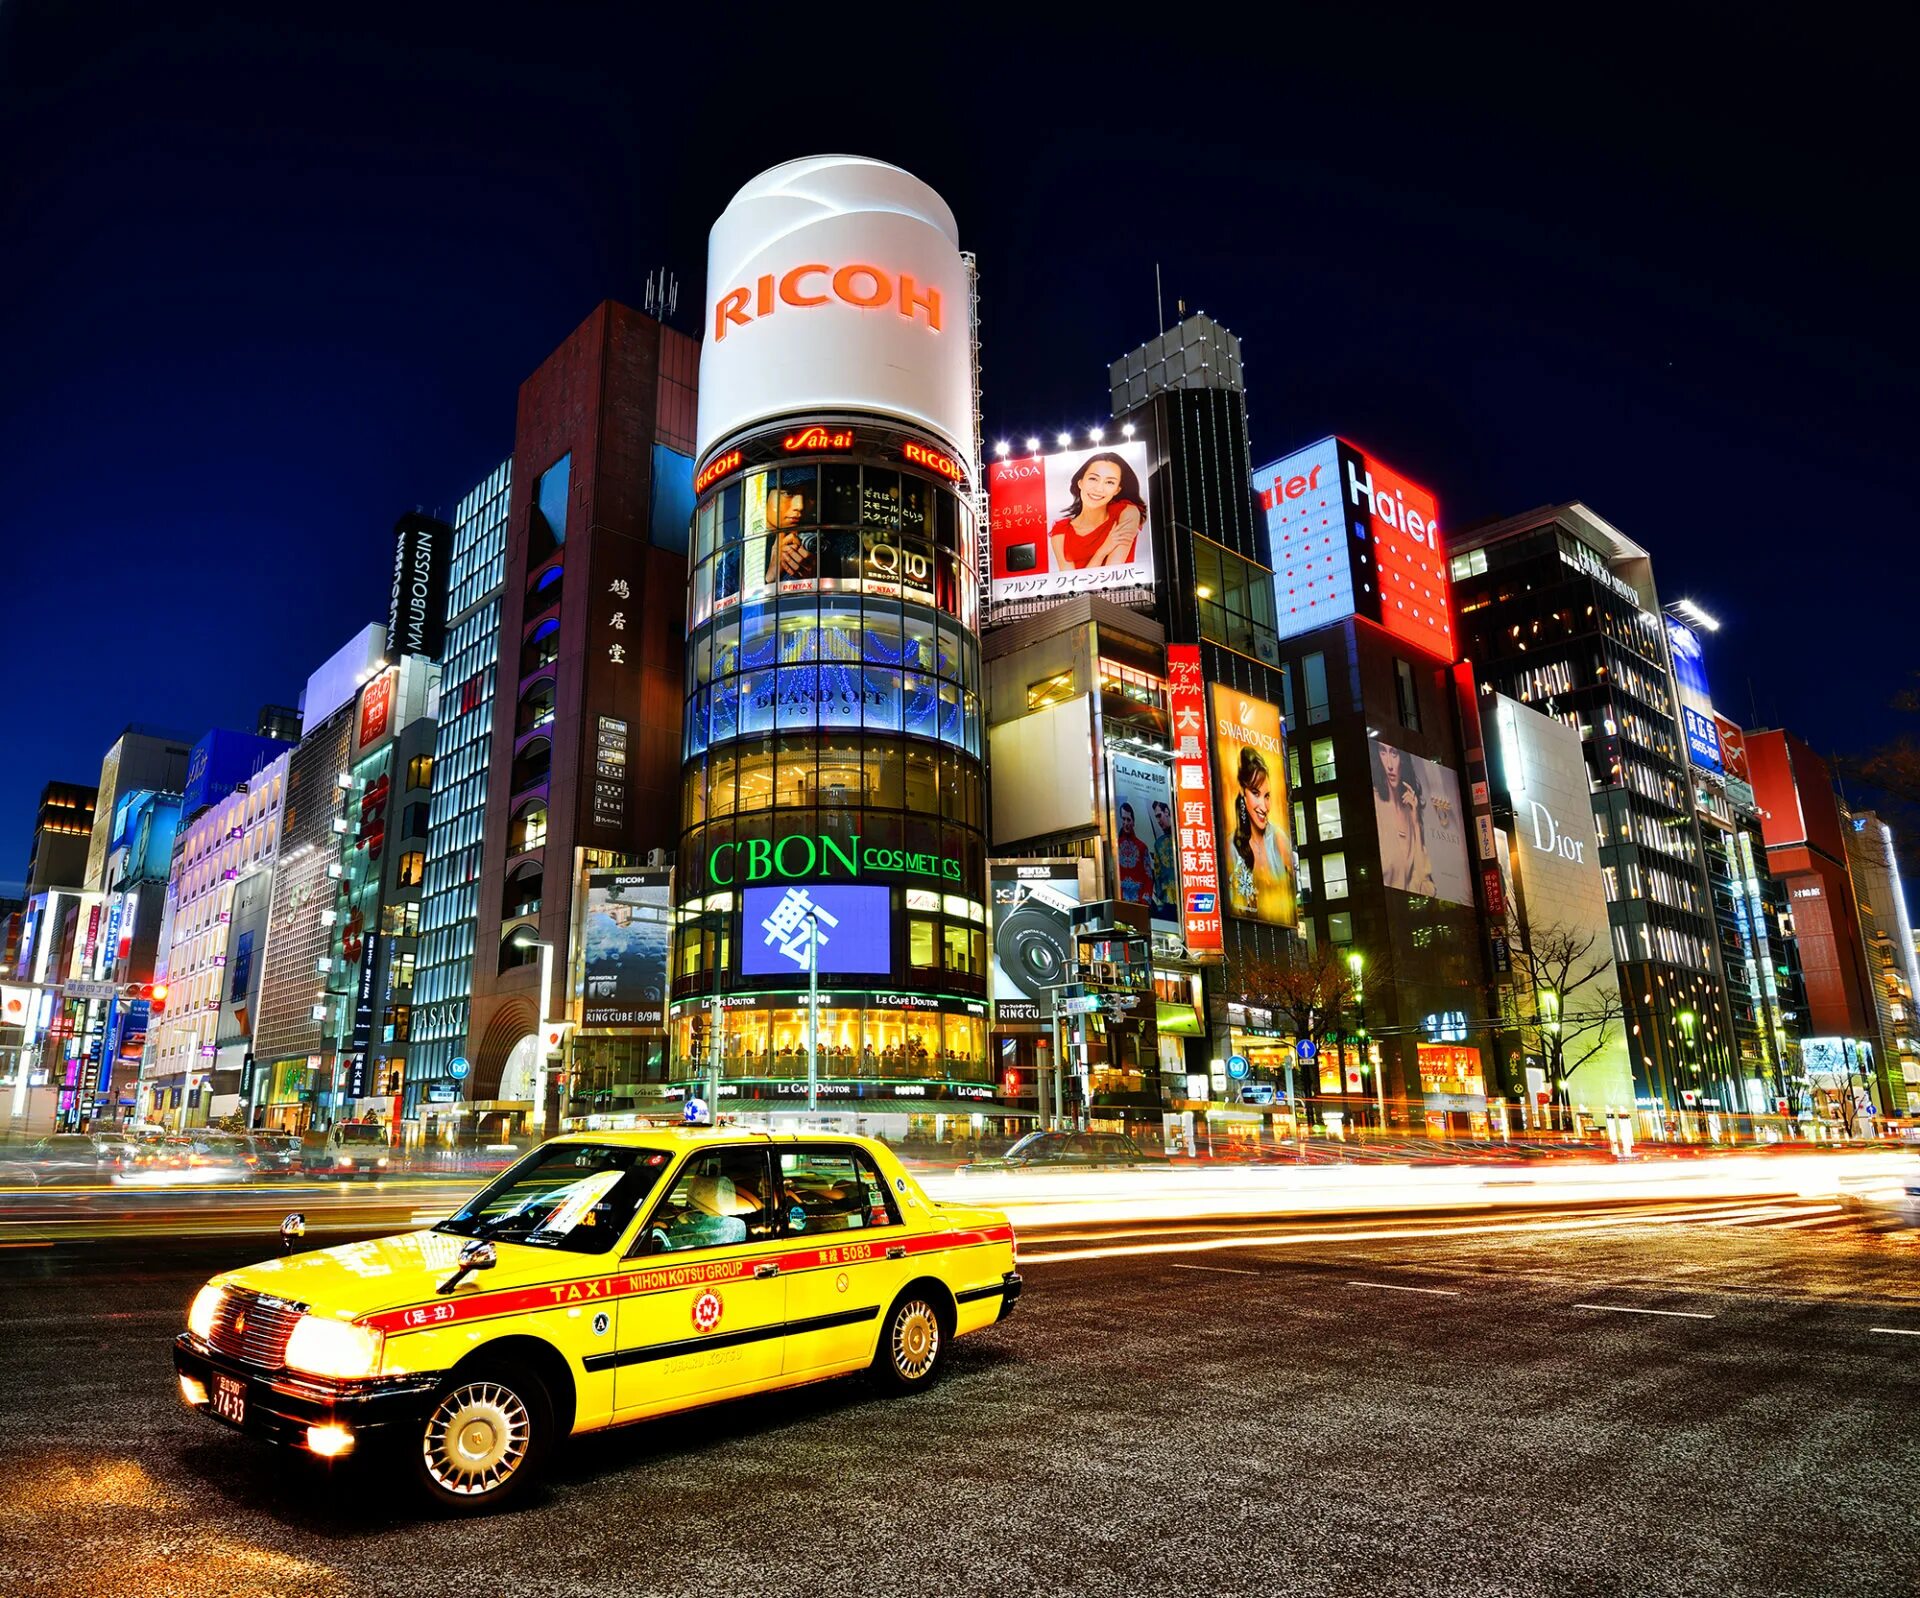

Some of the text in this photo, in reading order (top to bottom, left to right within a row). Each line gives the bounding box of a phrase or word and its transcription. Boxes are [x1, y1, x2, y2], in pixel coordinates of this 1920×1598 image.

[715, 263, 943, 344] RICOH
[784, 427, 853, 451] San-ai
[696, 452, 741, 493] RICOH
[905, 444, 963, 483] RICOH
[995, 464, 1041, 481] ARSOA
[1348, 460, 1438, 550] Haier
[407, 531, 433, 650] MAUBOUSSIN
[1003, 567, 1145, 594] アルソア クイーンシルバー
[608, 578, 630, 664] 鳩居堂
[1168, 662, 1199, 673] ブランド
[1180, 674, 1189, 683] &
[757, 688, 888, 709] BRAND OFF
[1171, 683, 1201, 695] チケット
[788, 706, 851, 715] TOYO
[1176, 705, 1206, 790] 大黒屋
[1219, 719, 1280, 754] SWAROVSKI
[1116, 765, 1151, 781] LILANZ
[1183, 802, 1206, 827] 質
[1181, 828, 1212, 850] 買取
[1529, 799, 1585, 864] Dior
[709, 835, 861, 885] C'BON
[1183, 851, 1214, 873] 販売
[615, 876, 645, 885] RICOH
[126, 902, 134, 927] docomo
[1197, 920, 1219, 932] B1F
[728, 997, 756, 1006] DOUTOR
[911, 996, 939, 1007] DOUTOR
[411, 1002, 465, 1030] TASAKI
[586, 1012, 608, 1022] RING
[610, 1012, 633, 1022] CUBE
[1000, 1009, 1025, 1019] RING
[816, 1084, 851, 1093] DOUTOR
[842, 1244, 872, 1261] 5083
[550, 1261, 743, 1303] TAXI NIHON KOTSU GROUP
[703, 1304, 712, 1317] N
[707, 1348, 743, 1367] KOTSU
[218, 1390, 245, 1422] 74-33
